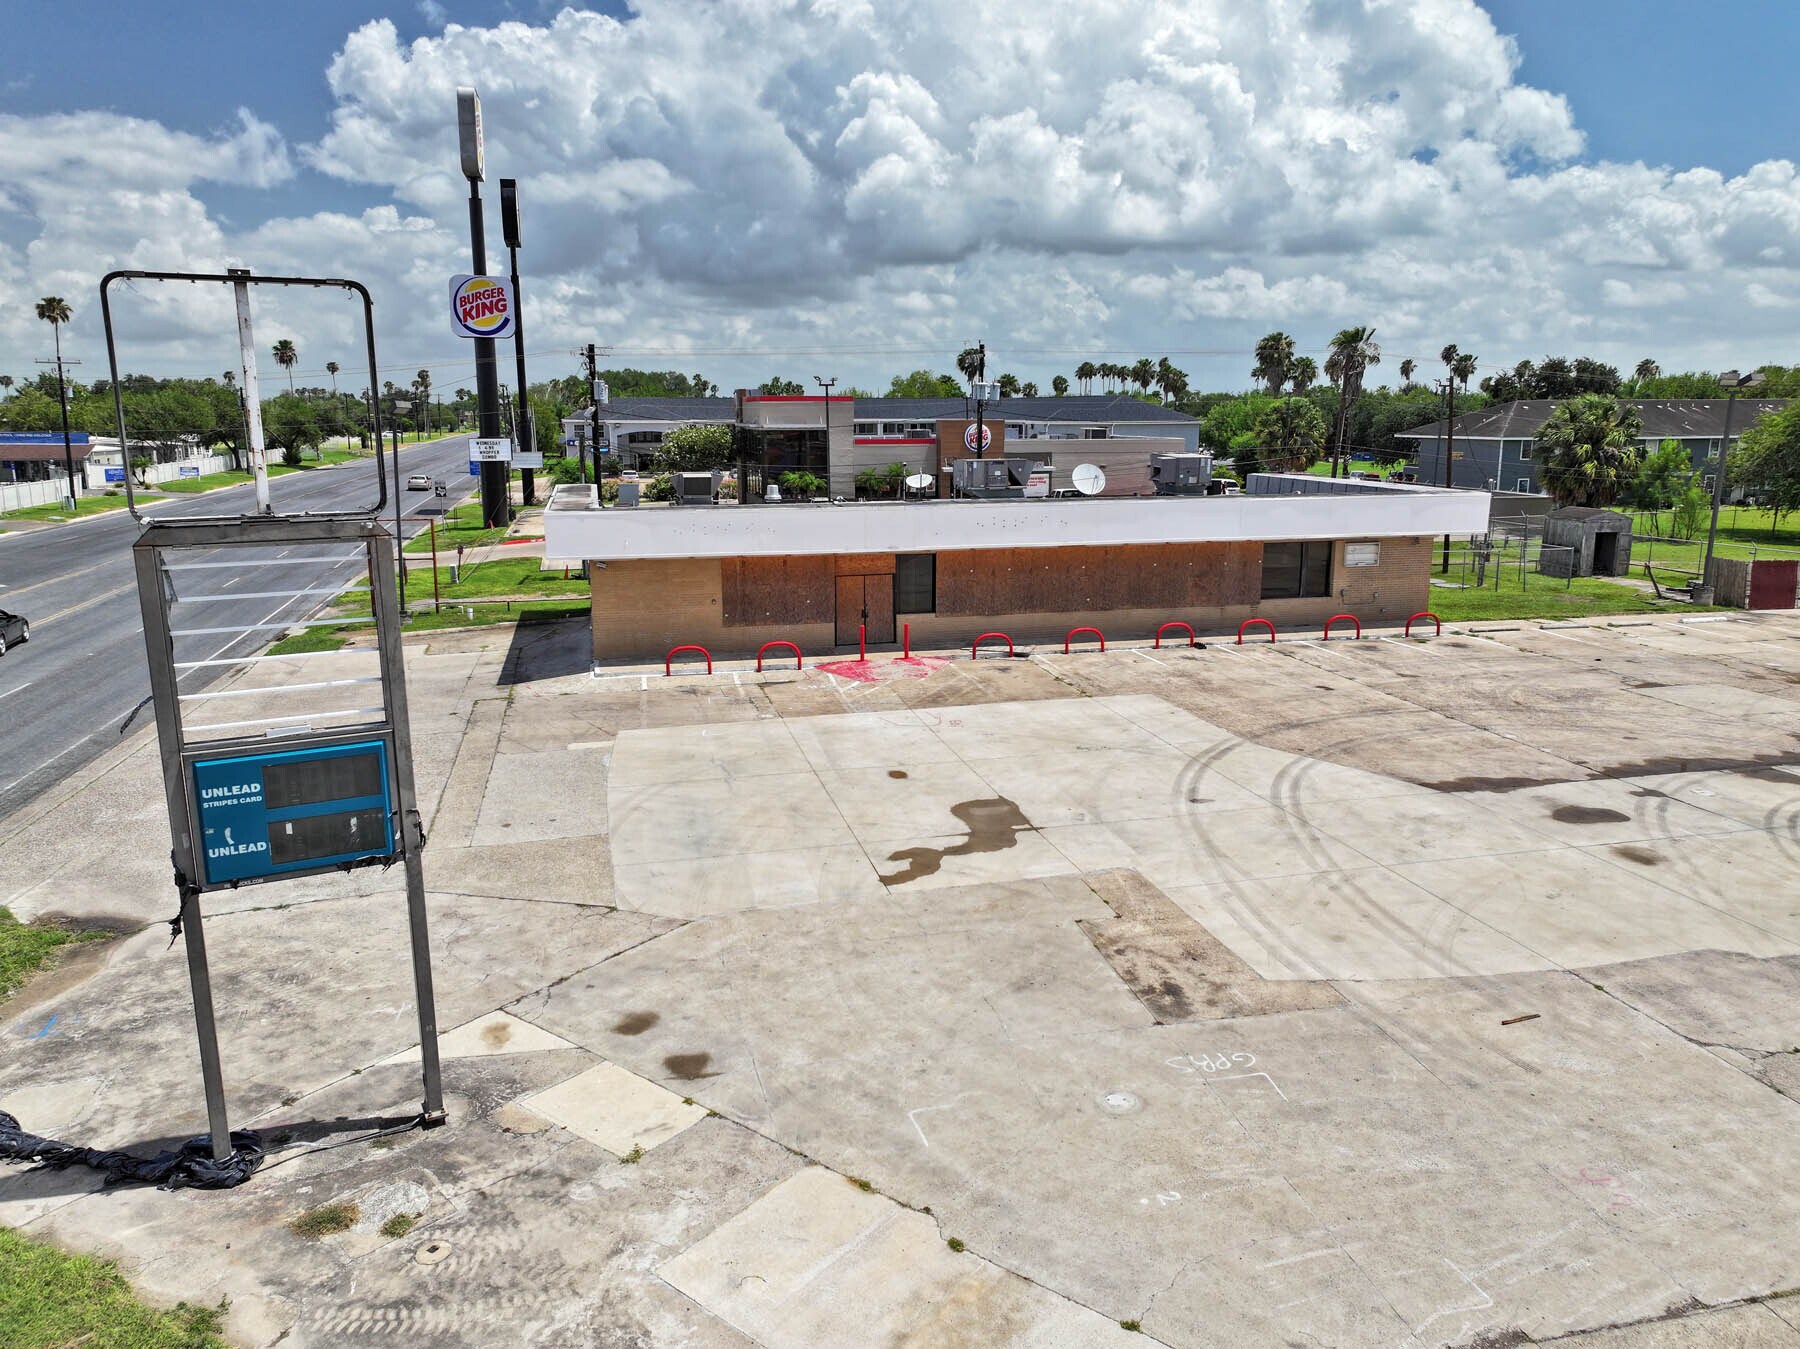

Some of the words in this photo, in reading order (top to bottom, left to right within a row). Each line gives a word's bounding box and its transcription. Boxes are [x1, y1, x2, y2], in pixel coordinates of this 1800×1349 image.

[459, 287, 505, 308] BURGER
[462, 298, 507, 324] KING
[201, 783, 261, 798] UNLEAD
[203, 799, 239, 808] STRIPES
[240, 796, 263, 804] CARD
[208, 842, 267, 858] UNLEAD
